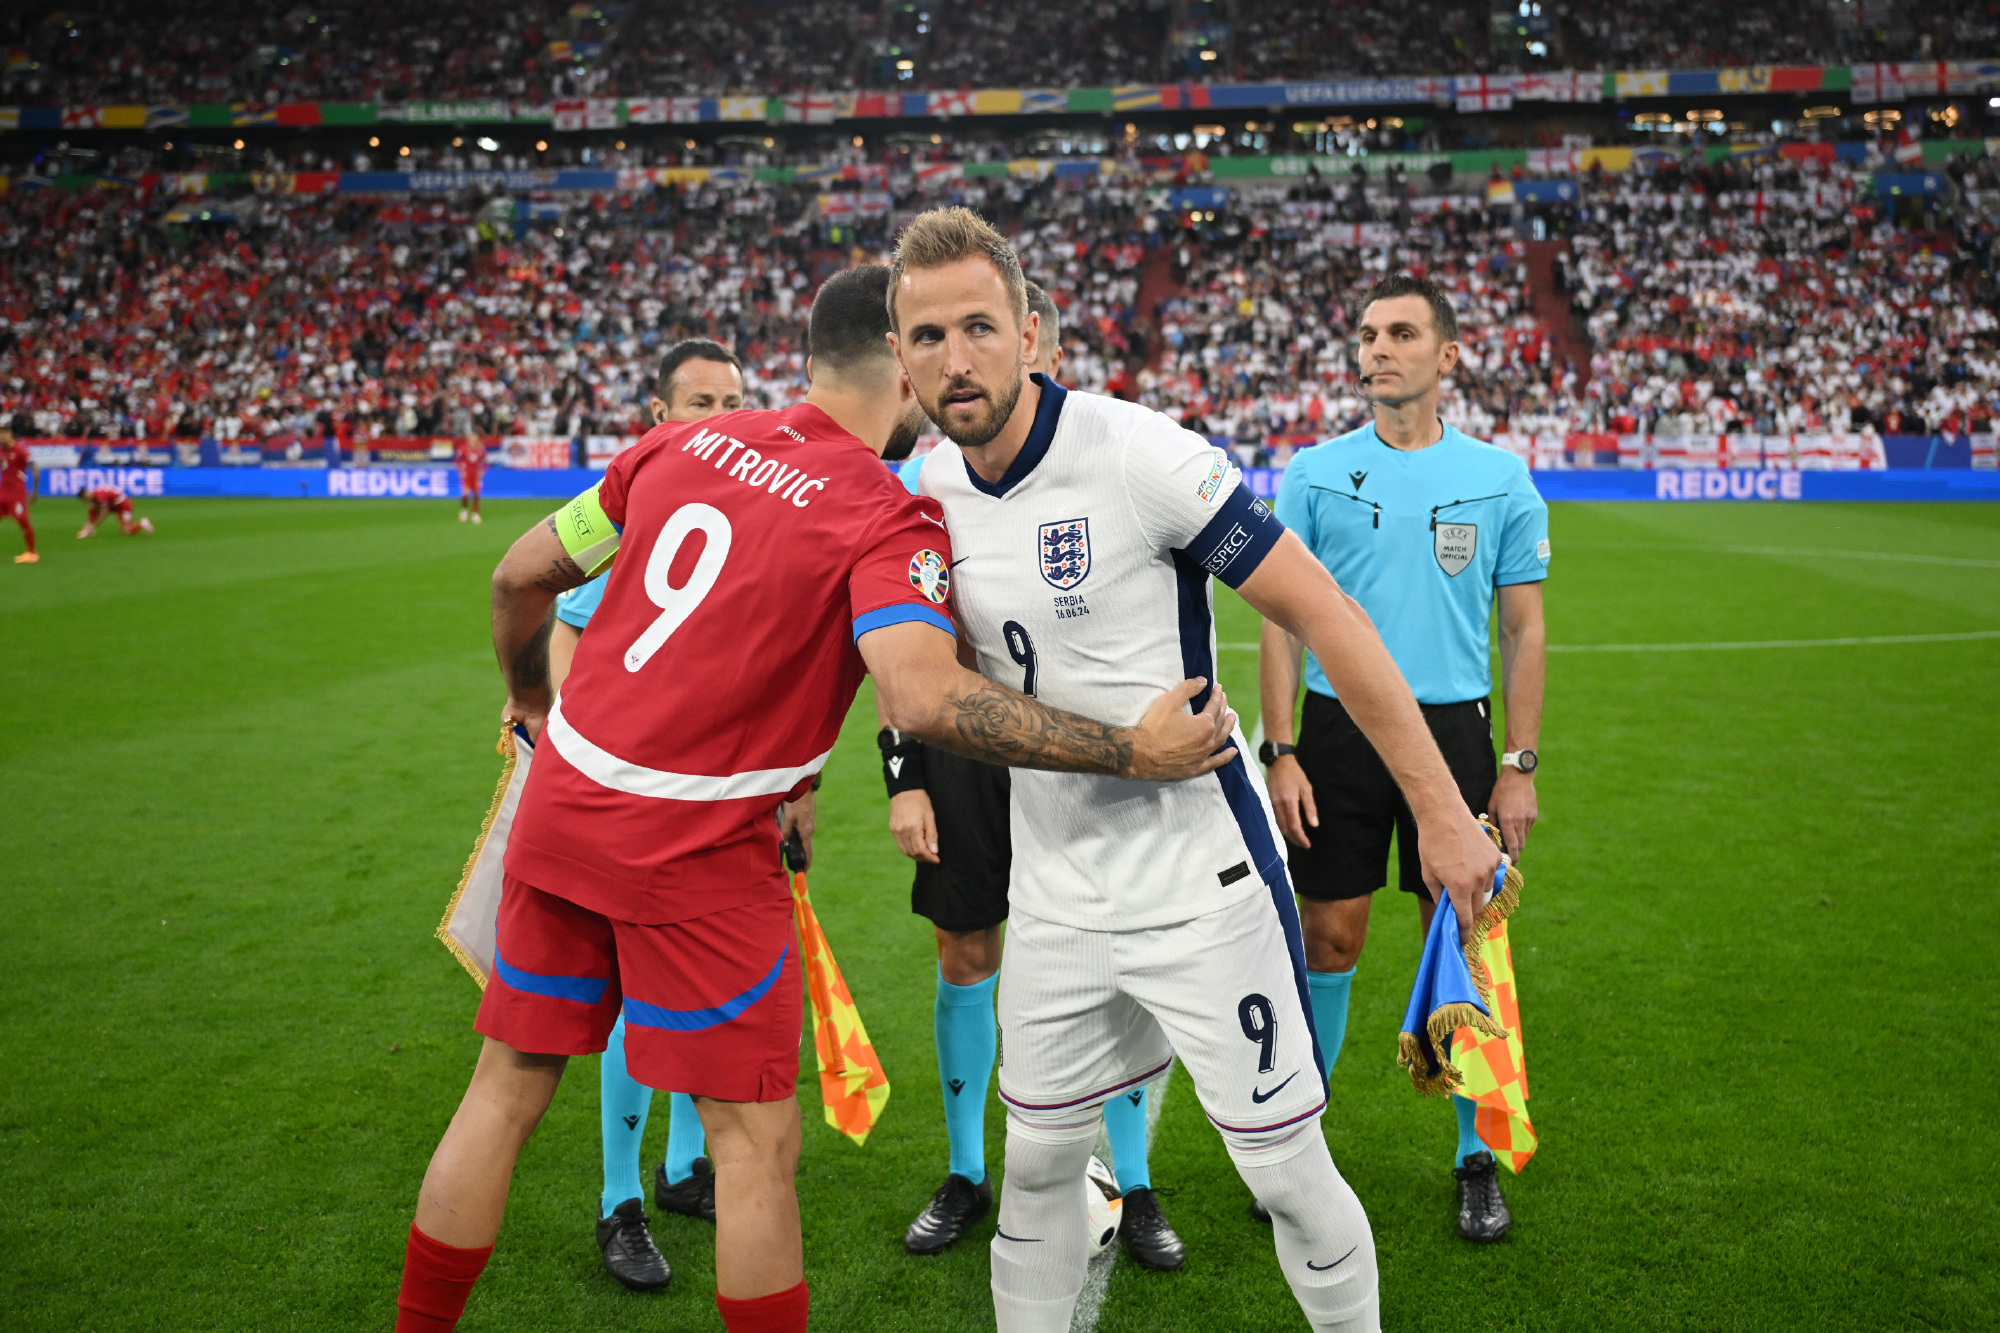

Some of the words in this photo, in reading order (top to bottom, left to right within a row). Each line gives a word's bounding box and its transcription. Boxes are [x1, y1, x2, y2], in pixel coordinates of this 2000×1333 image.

[328, 470, 450, 496] REDUCE
[682, 428, 830, 508] MITROVIĆ
[1656, 470, 1802, 500] REDUCE
[572, 500, 591, 536] SPECT
[1443, 529, 1467, 540] UEFA
[624, 502, 732, 673] 9
[1053, 594, 1085, 607] SERBIA
[1055, 605, 1090, 619] 16.06.24
[1002, 619, 1038, 698] 9
[1237, 992, 1278, 1074] 9
